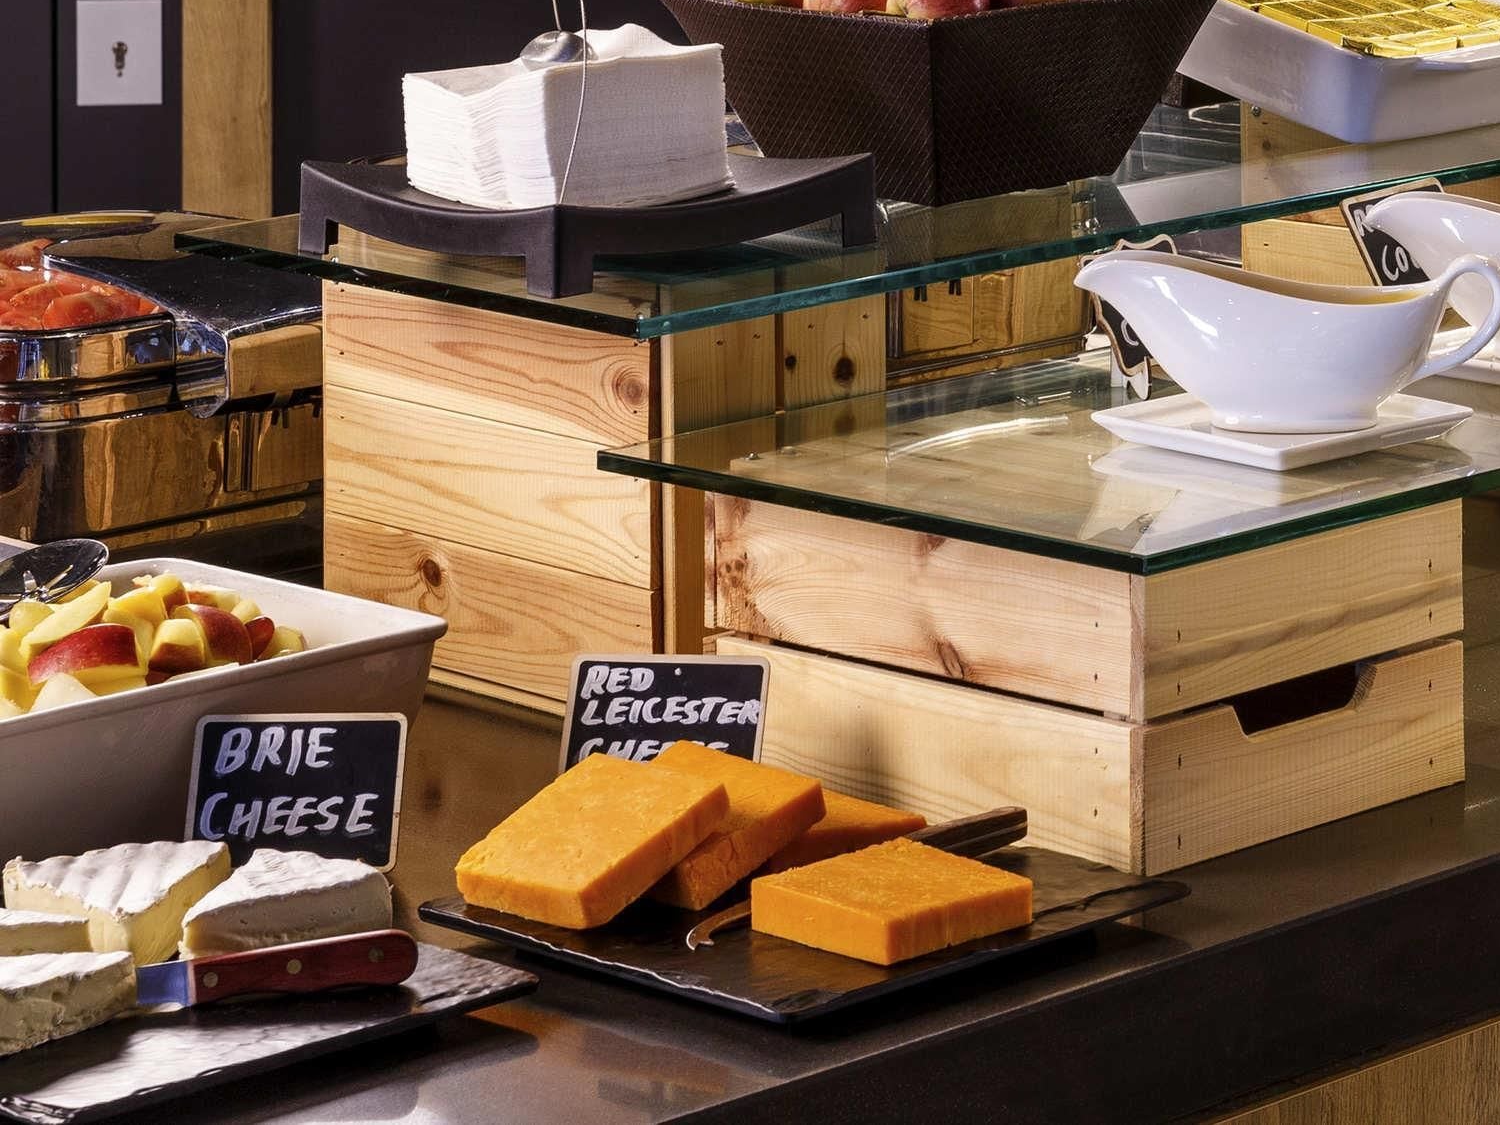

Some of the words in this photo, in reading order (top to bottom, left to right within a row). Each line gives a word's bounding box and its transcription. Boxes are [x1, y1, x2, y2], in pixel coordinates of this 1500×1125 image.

[581, 665, 655, 700] RED
[580, 696, 762, 726] LEICESTER
[214, 725, 338, 776] BRIE
[578, 737, 731, 764] CHE
[200, 791, 380, 841] CHEESE
